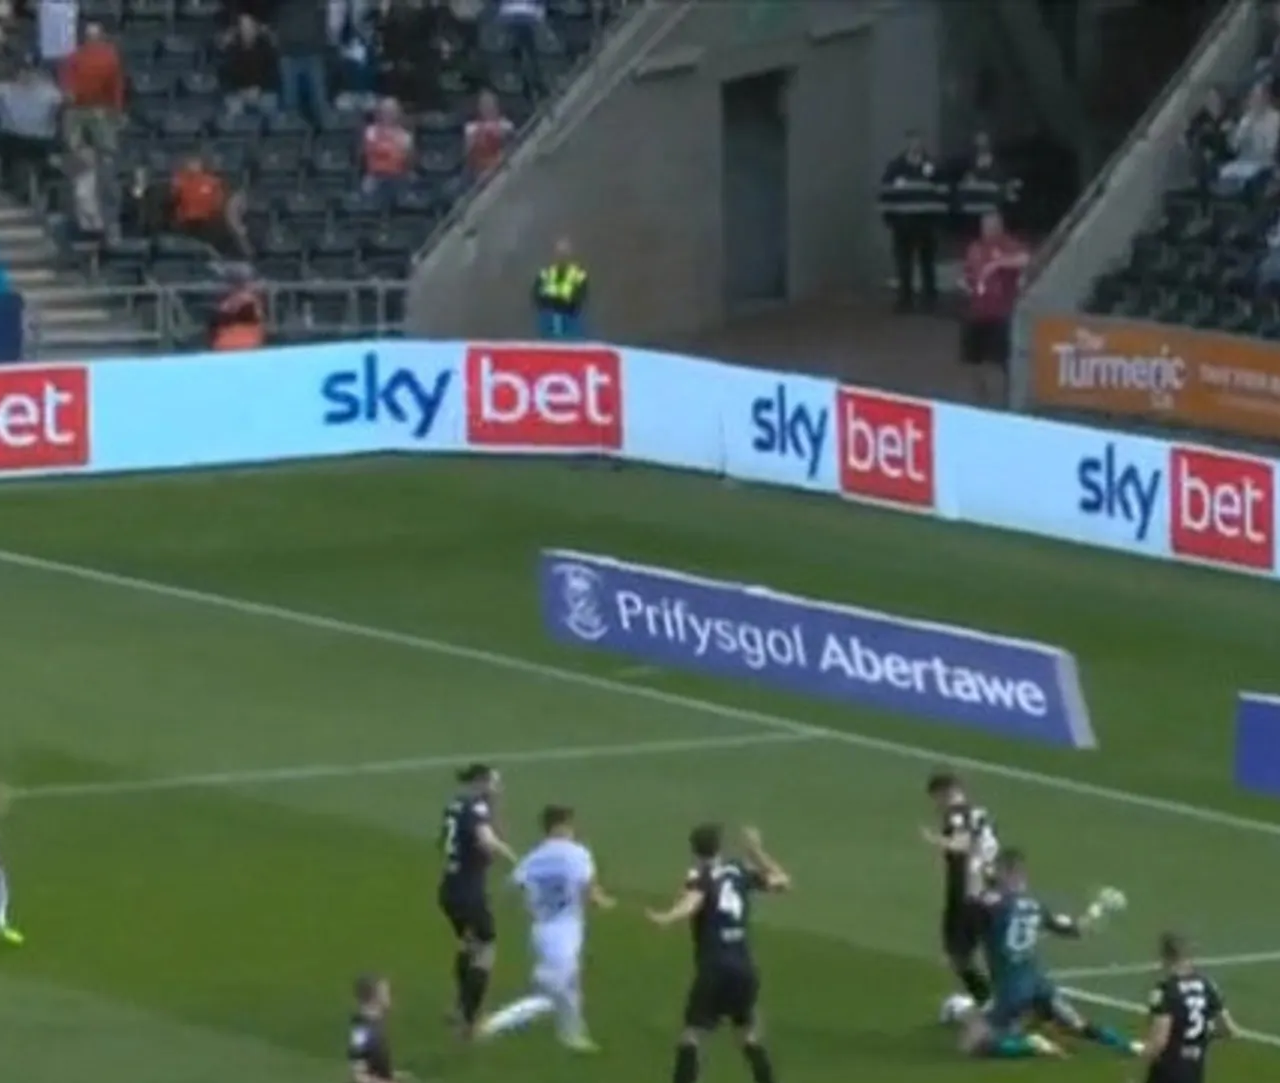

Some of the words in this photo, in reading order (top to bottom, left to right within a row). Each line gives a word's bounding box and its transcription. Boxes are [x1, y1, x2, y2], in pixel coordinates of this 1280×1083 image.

[321, 351, 453, 439] sky
[480, 356, 614, 424] bet
[1052, 343, 1187, 392] Turmeric
[752, 383, 828, 479] sky
[846, 402, 926, 483] bet
[1078, 443, 1161, 541] sky
[1180, 456, 1266, 543] bet
[615, 590, 807, 669] Prifysgol
[819, 633, 1048, 718] Abertawe
[718, 877, 744, 921] 4
[1183, 995, 1208, 1040] 3
